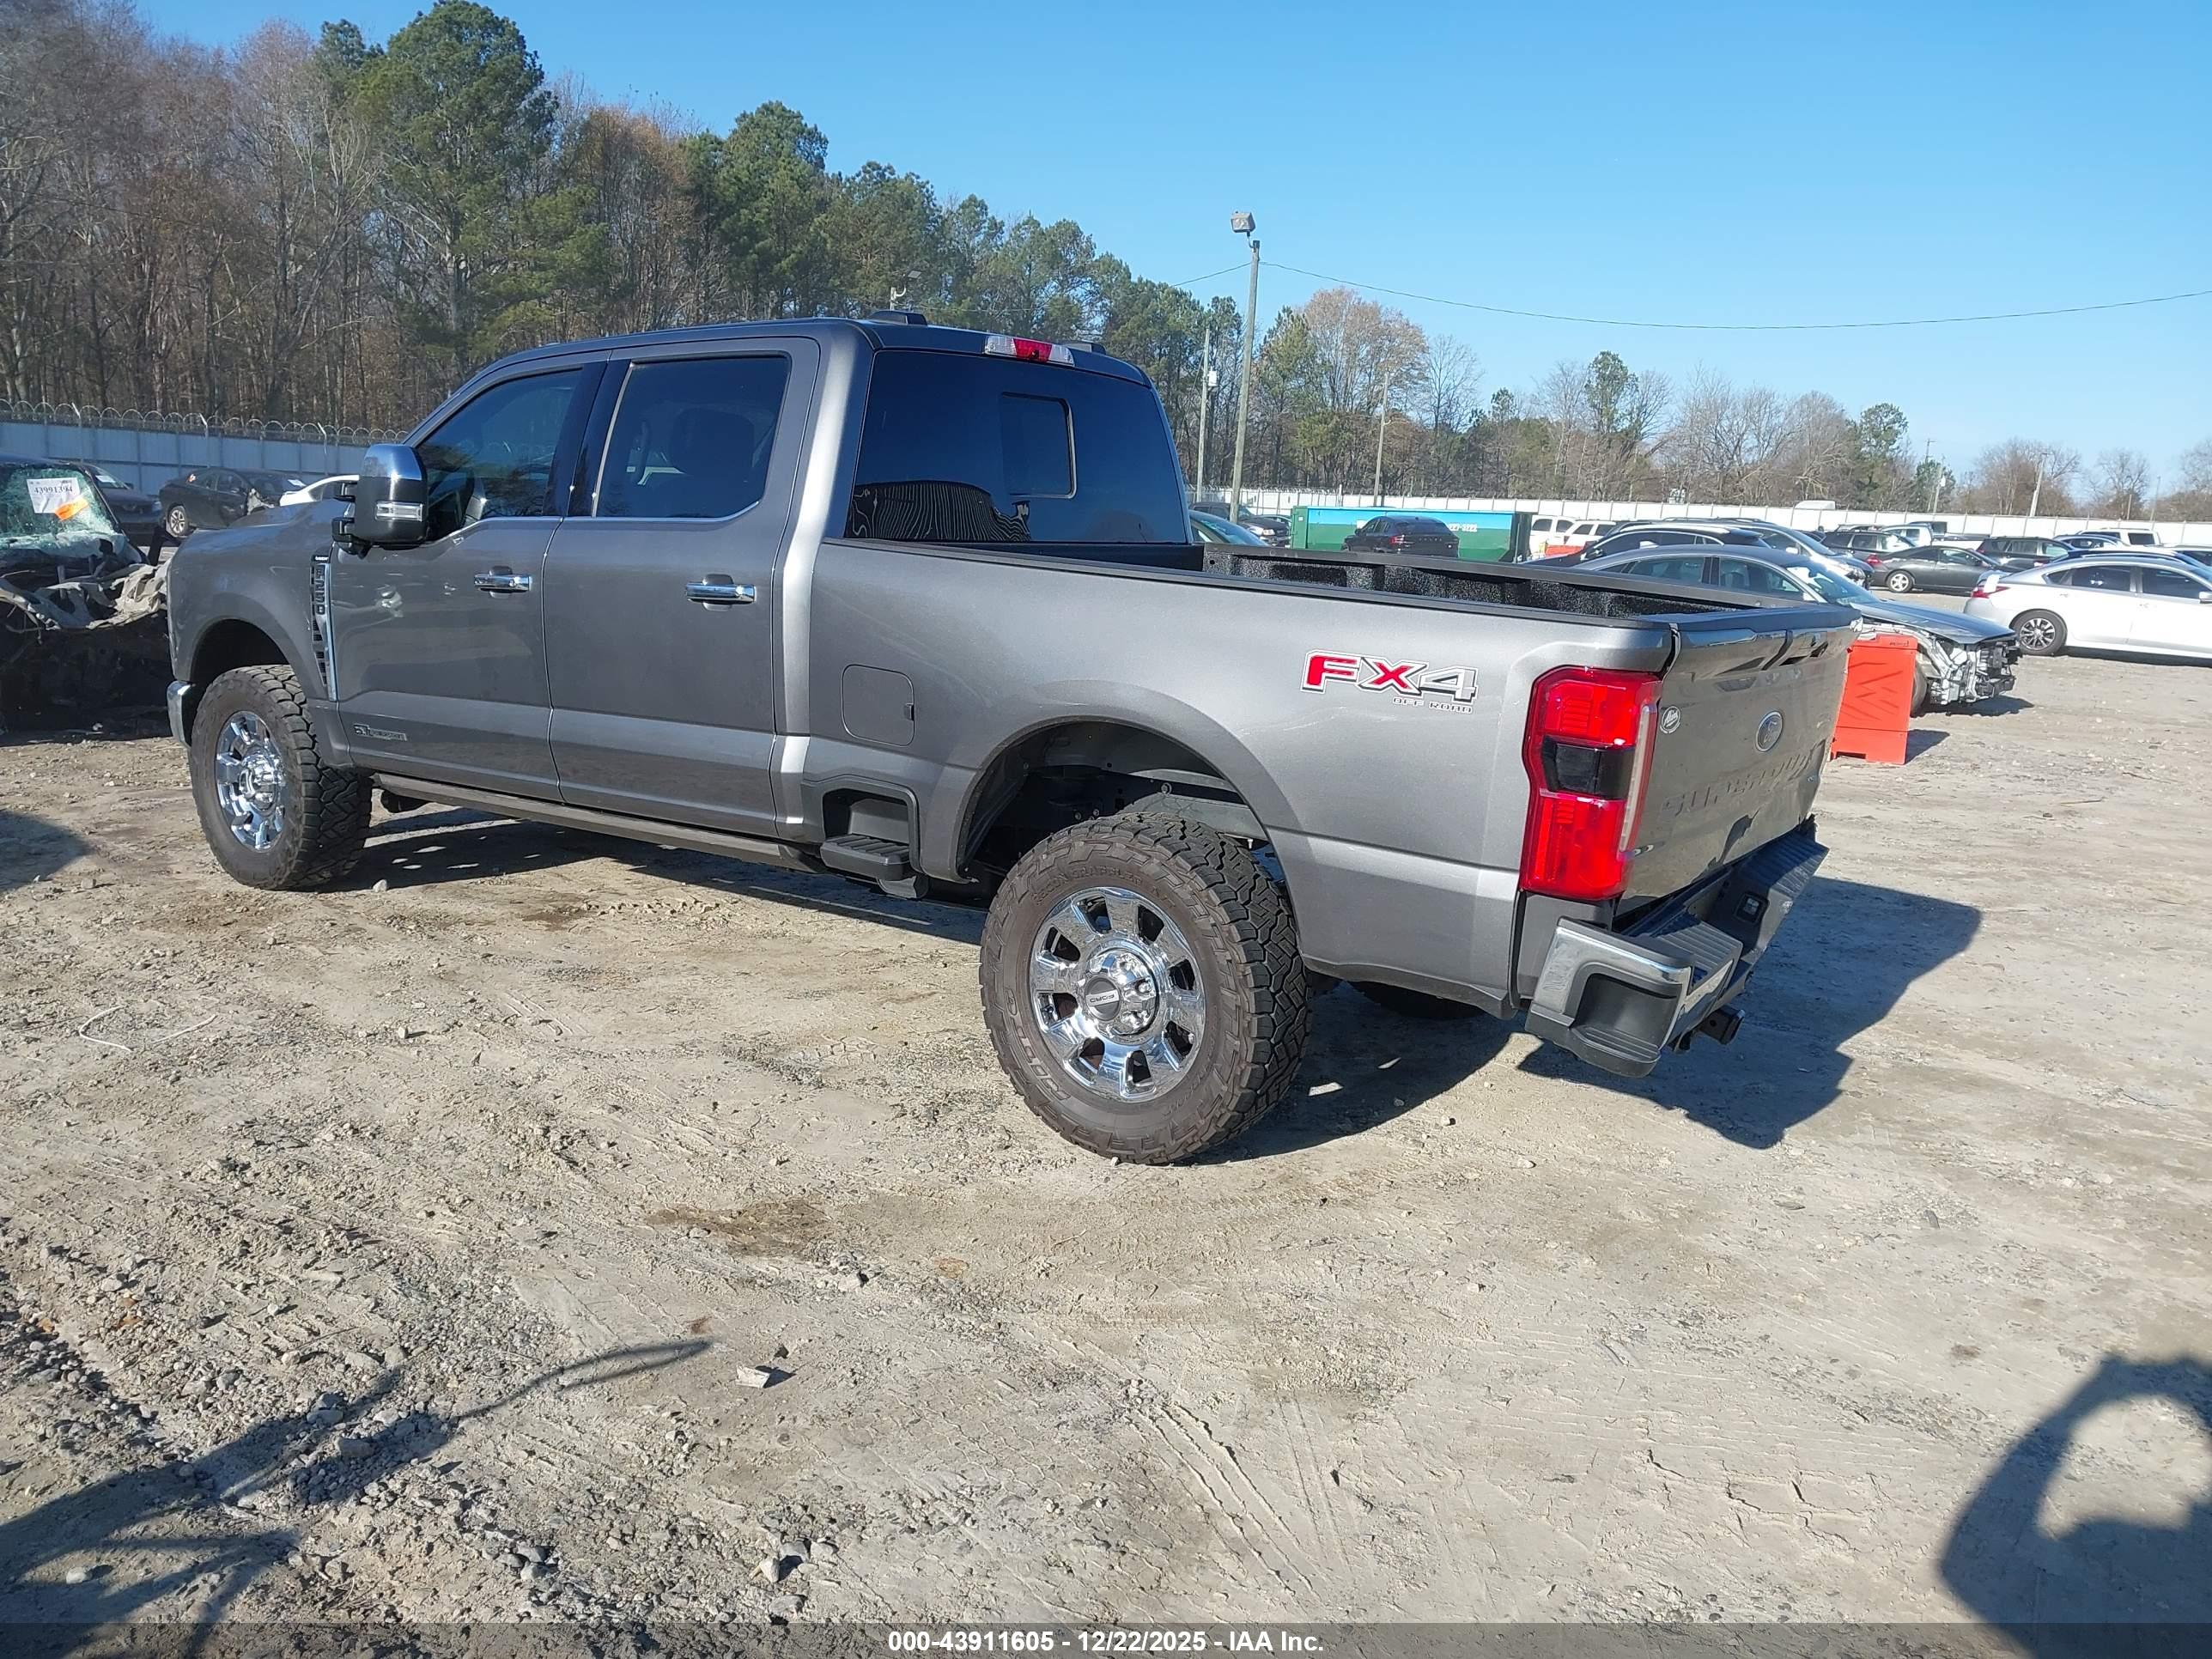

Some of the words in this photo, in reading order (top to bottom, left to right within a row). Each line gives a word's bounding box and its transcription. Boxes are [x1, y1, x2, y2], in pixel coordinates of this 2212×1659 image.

[1300, 650, 1478, 704] FX4
[1393, 696, 1424, 708] OFF
[1429, 701, 1474, 714] ROAD
[1089, 994, 1115, 1003] FORD
